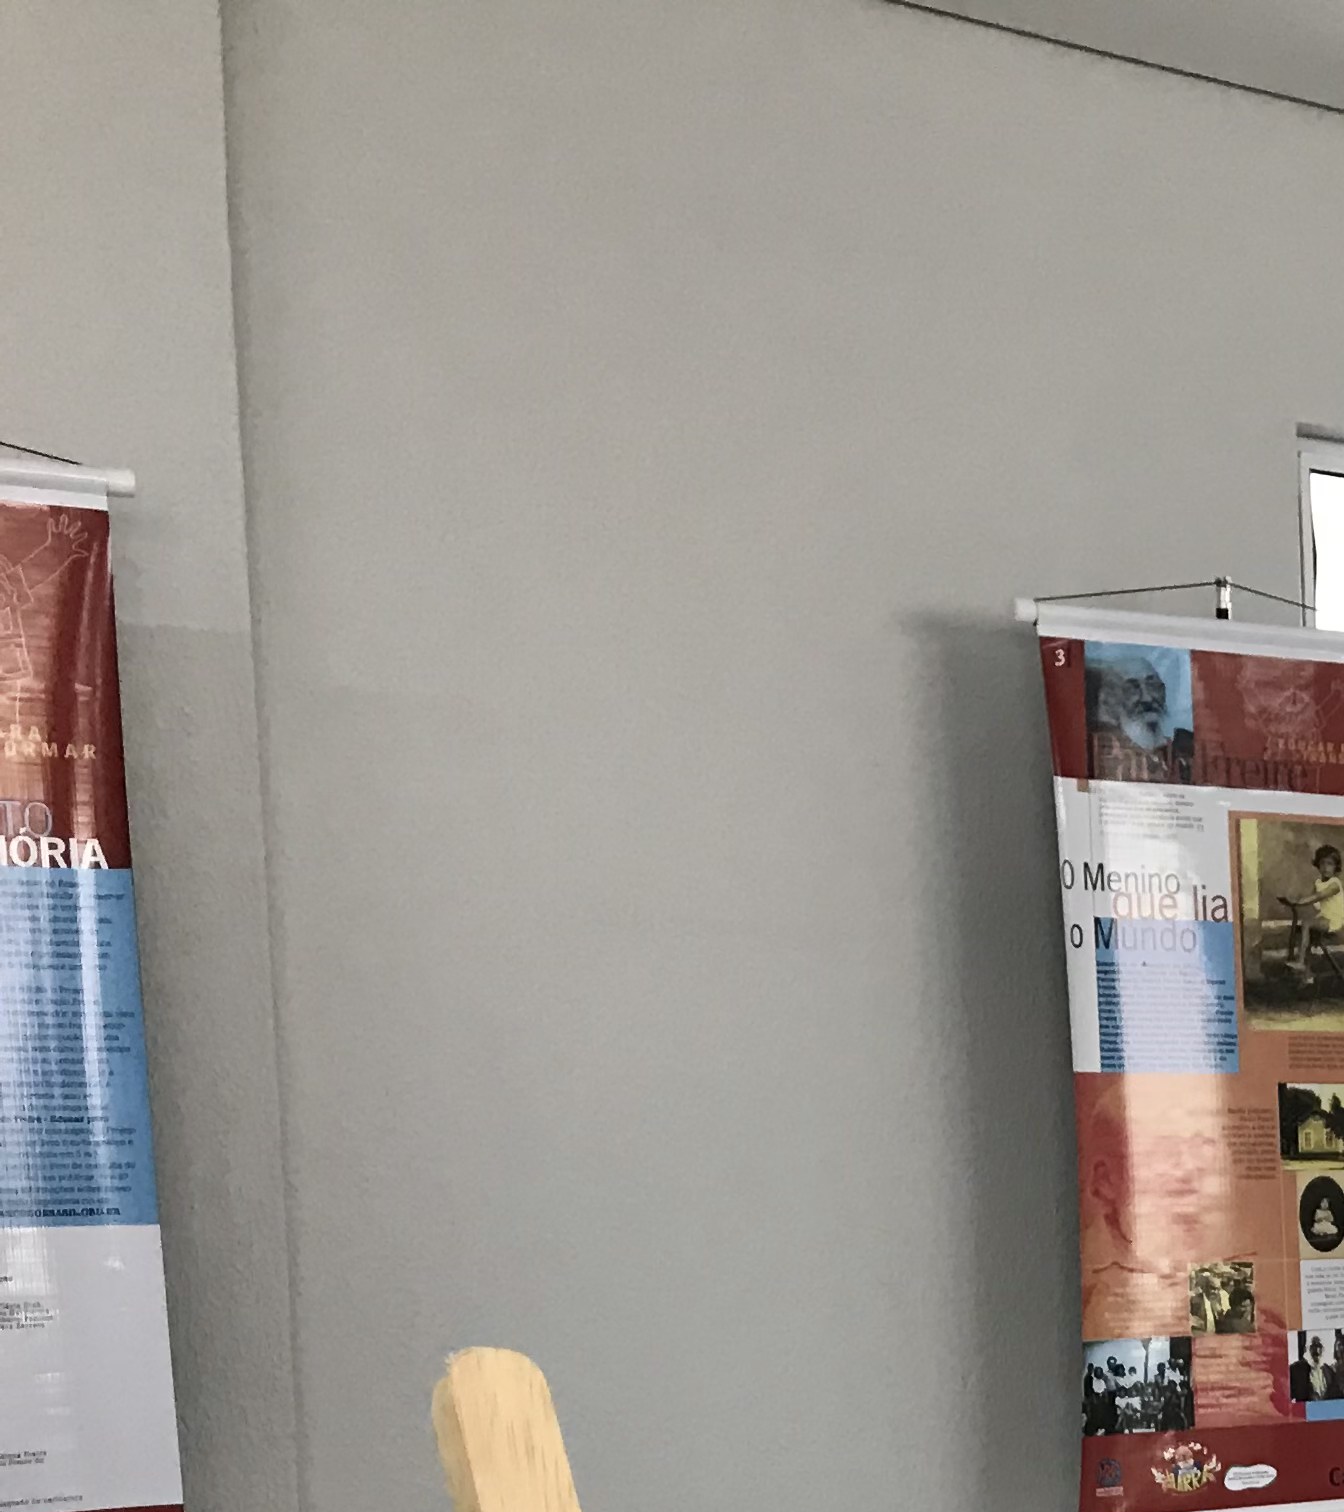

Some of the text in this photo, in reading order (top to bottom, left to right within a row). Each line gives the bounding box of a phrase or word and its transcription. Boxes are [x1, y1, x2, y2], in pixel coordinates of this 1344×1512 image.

[1054, 648, 1066, 667] 3
[1060, 857, 1181, 895] O Menino
[1112, 884, 1230, 923] que lia
[1069, 916, 1198, 953] o Mundo
